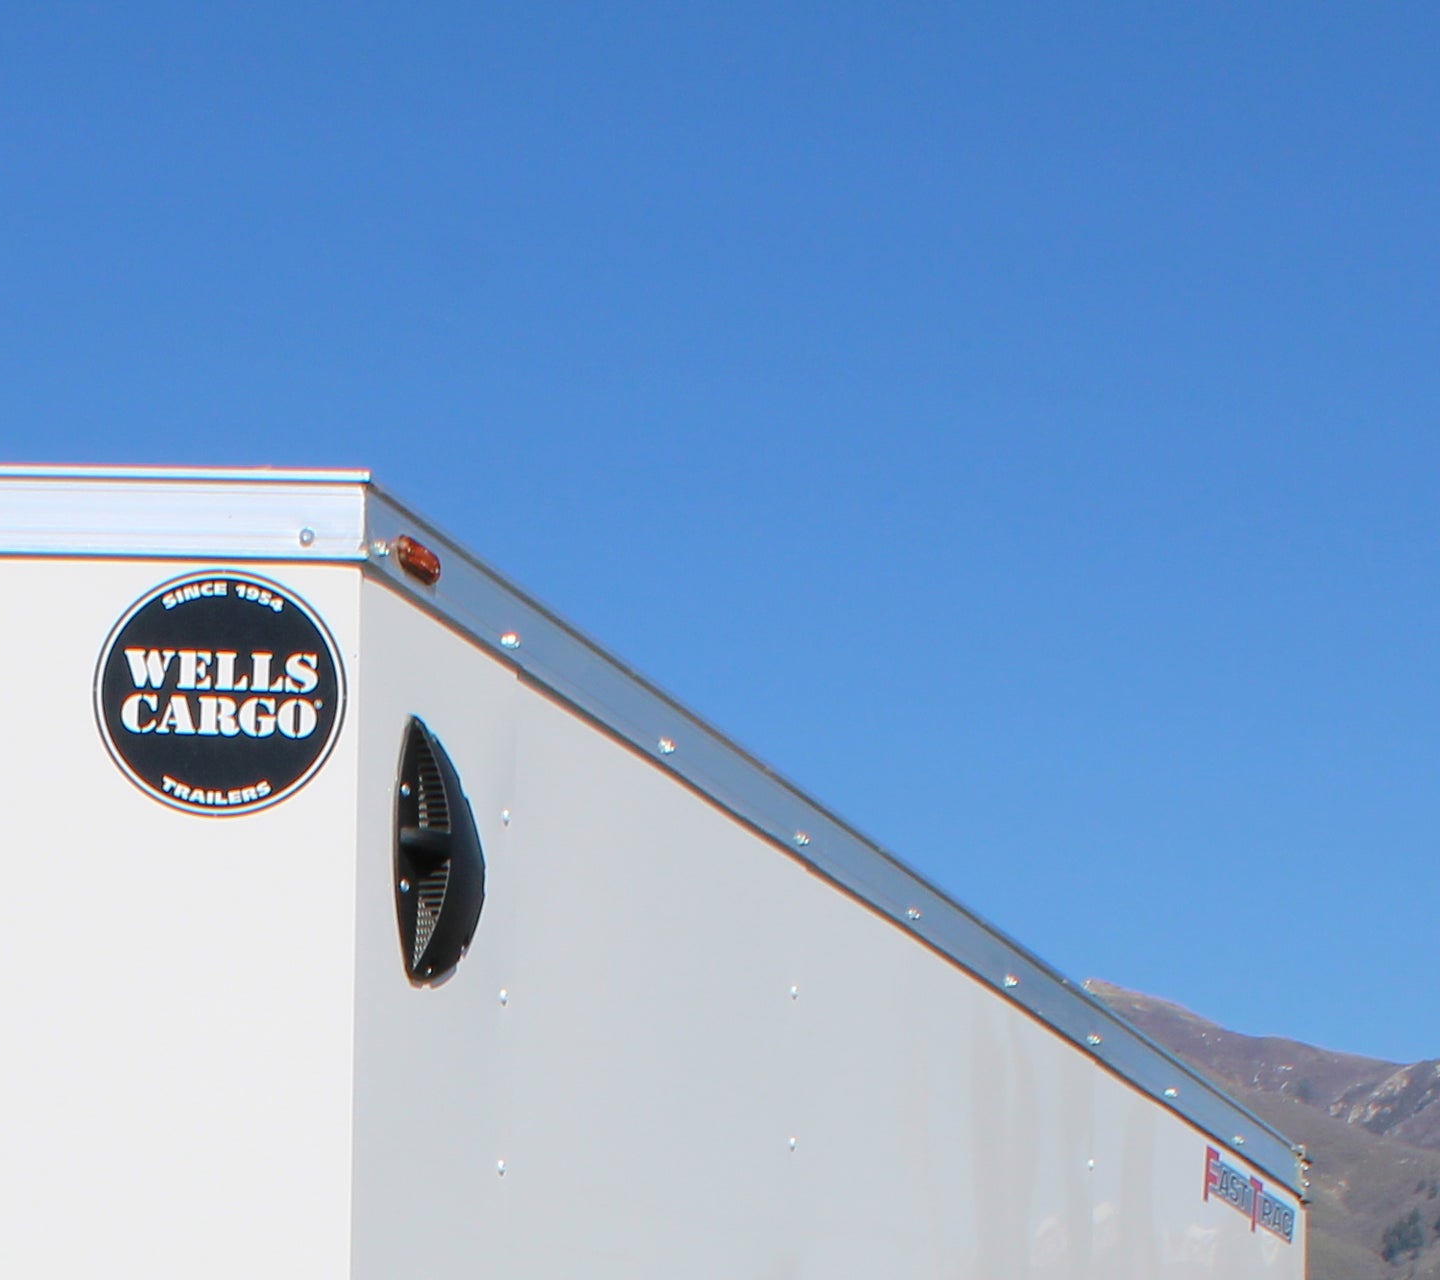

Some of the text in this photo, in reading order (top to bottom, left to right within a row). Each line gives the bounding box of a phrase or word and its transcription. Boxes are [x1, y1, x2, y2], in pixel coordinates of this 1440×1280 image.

[161, 581, 286, 613] SINCE 1954
[123, 648, 320, 694] WELLS
[120, 692, 318, 740] CARGO
[161, 775, 272, 806] TRAILERS
